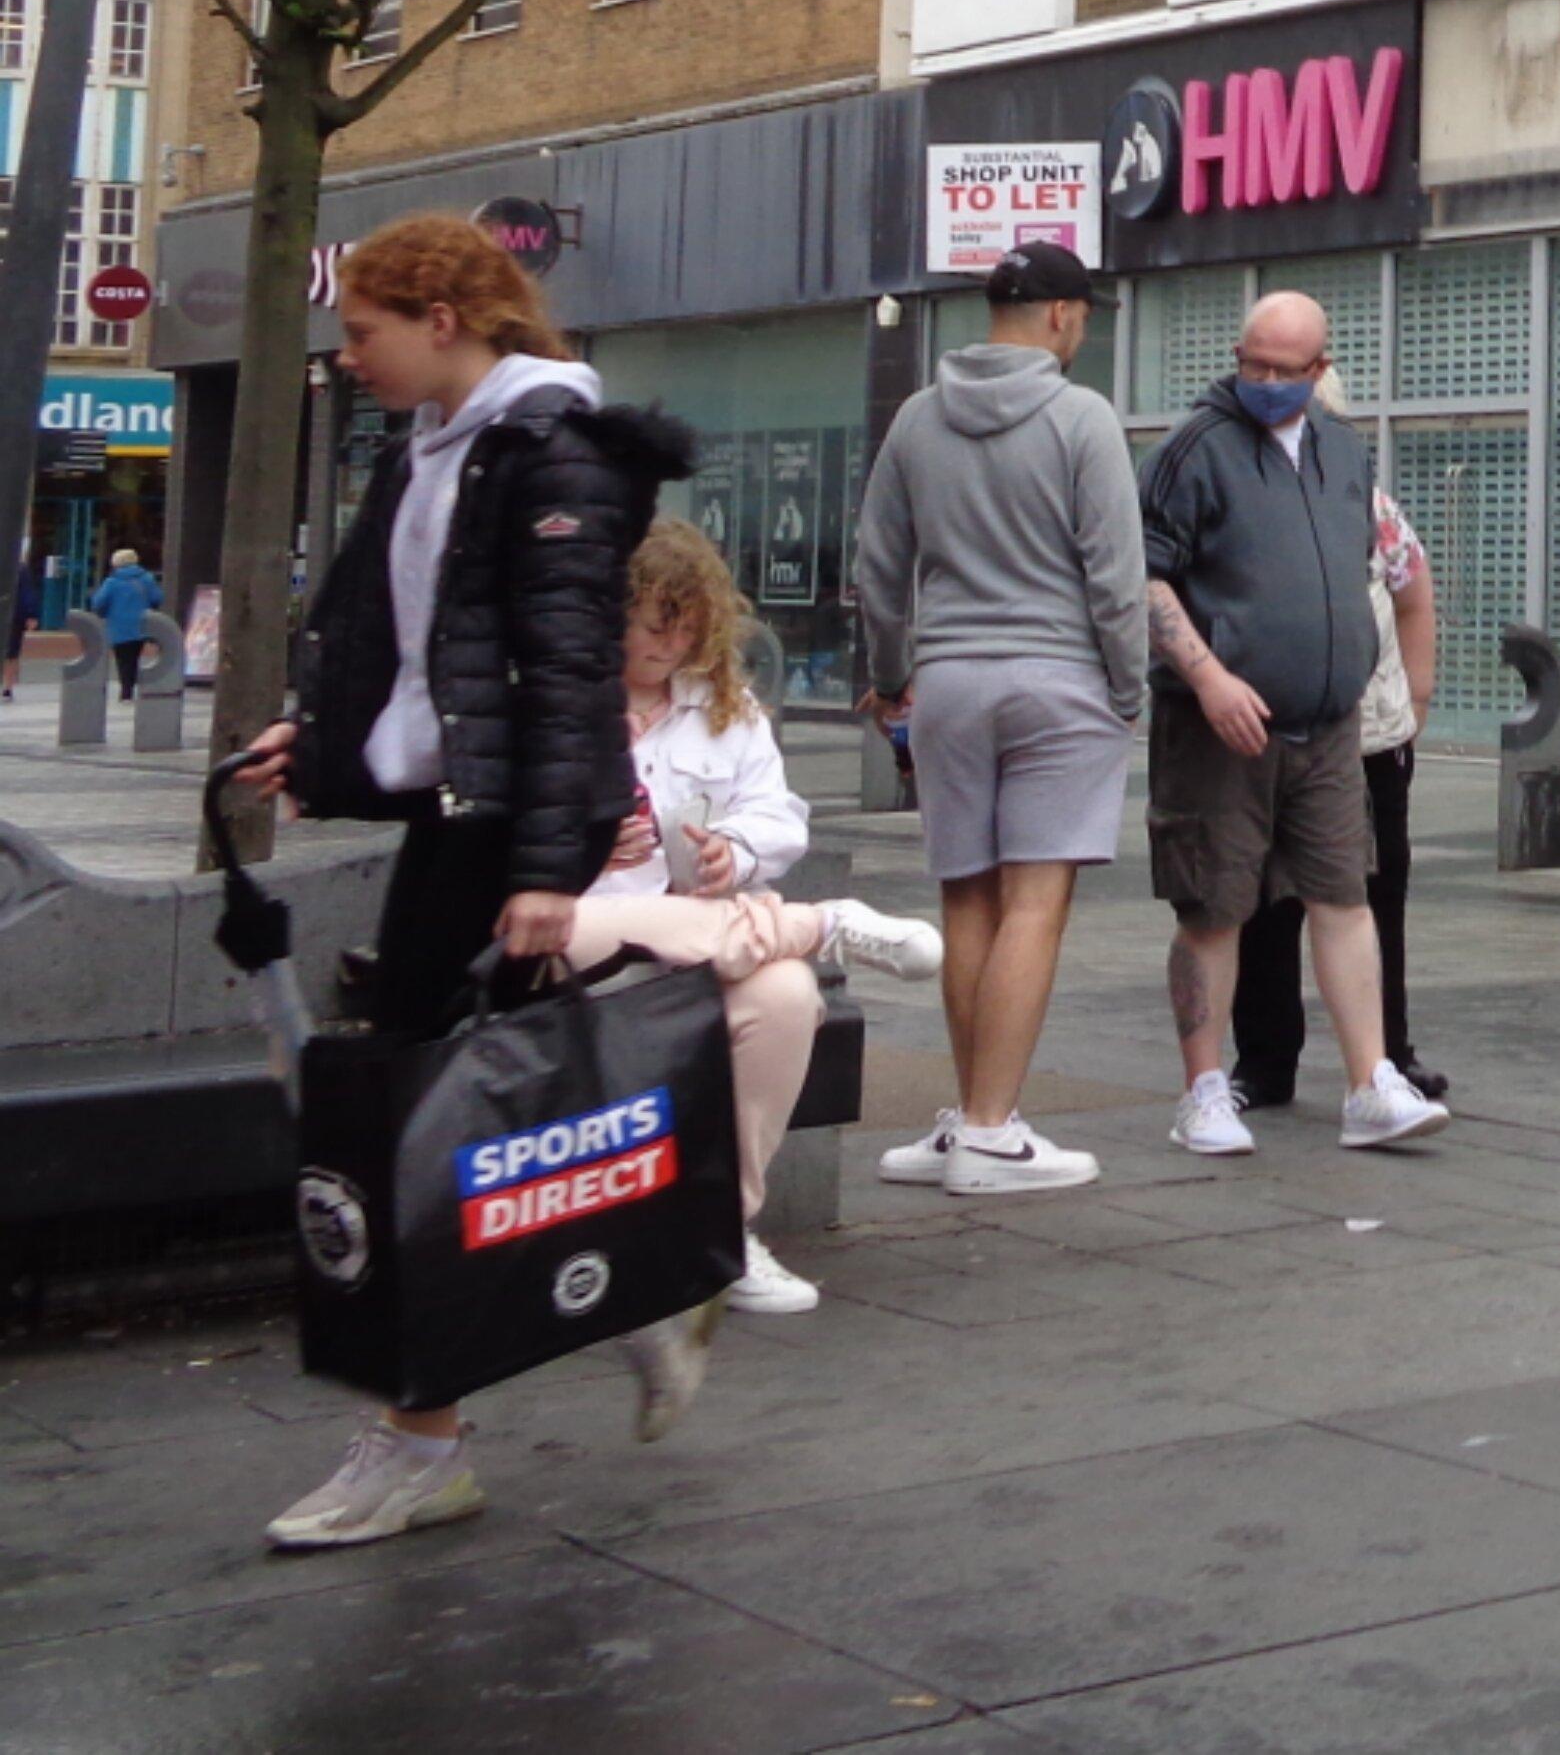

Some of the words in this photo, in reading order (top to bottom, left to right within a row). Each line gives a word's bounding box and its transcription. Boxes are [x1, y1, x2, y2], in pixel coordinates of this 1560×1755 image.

[1182, 46, 1403, 215] HMV
[963, 150, 1064, 163] SUBSTANTIAL
[943, 165, 1013, 183] SHOP
[1022, 164, 1084, 182] UNIT
[942, 185, 996, 212] TO
[1010, 183, 1086, 211] LET
[95, 286, 146, 300] COSTA
[471, 1096, 661, 1188] SPORTS
[478, 1147, 665, 1240] DIRECT
